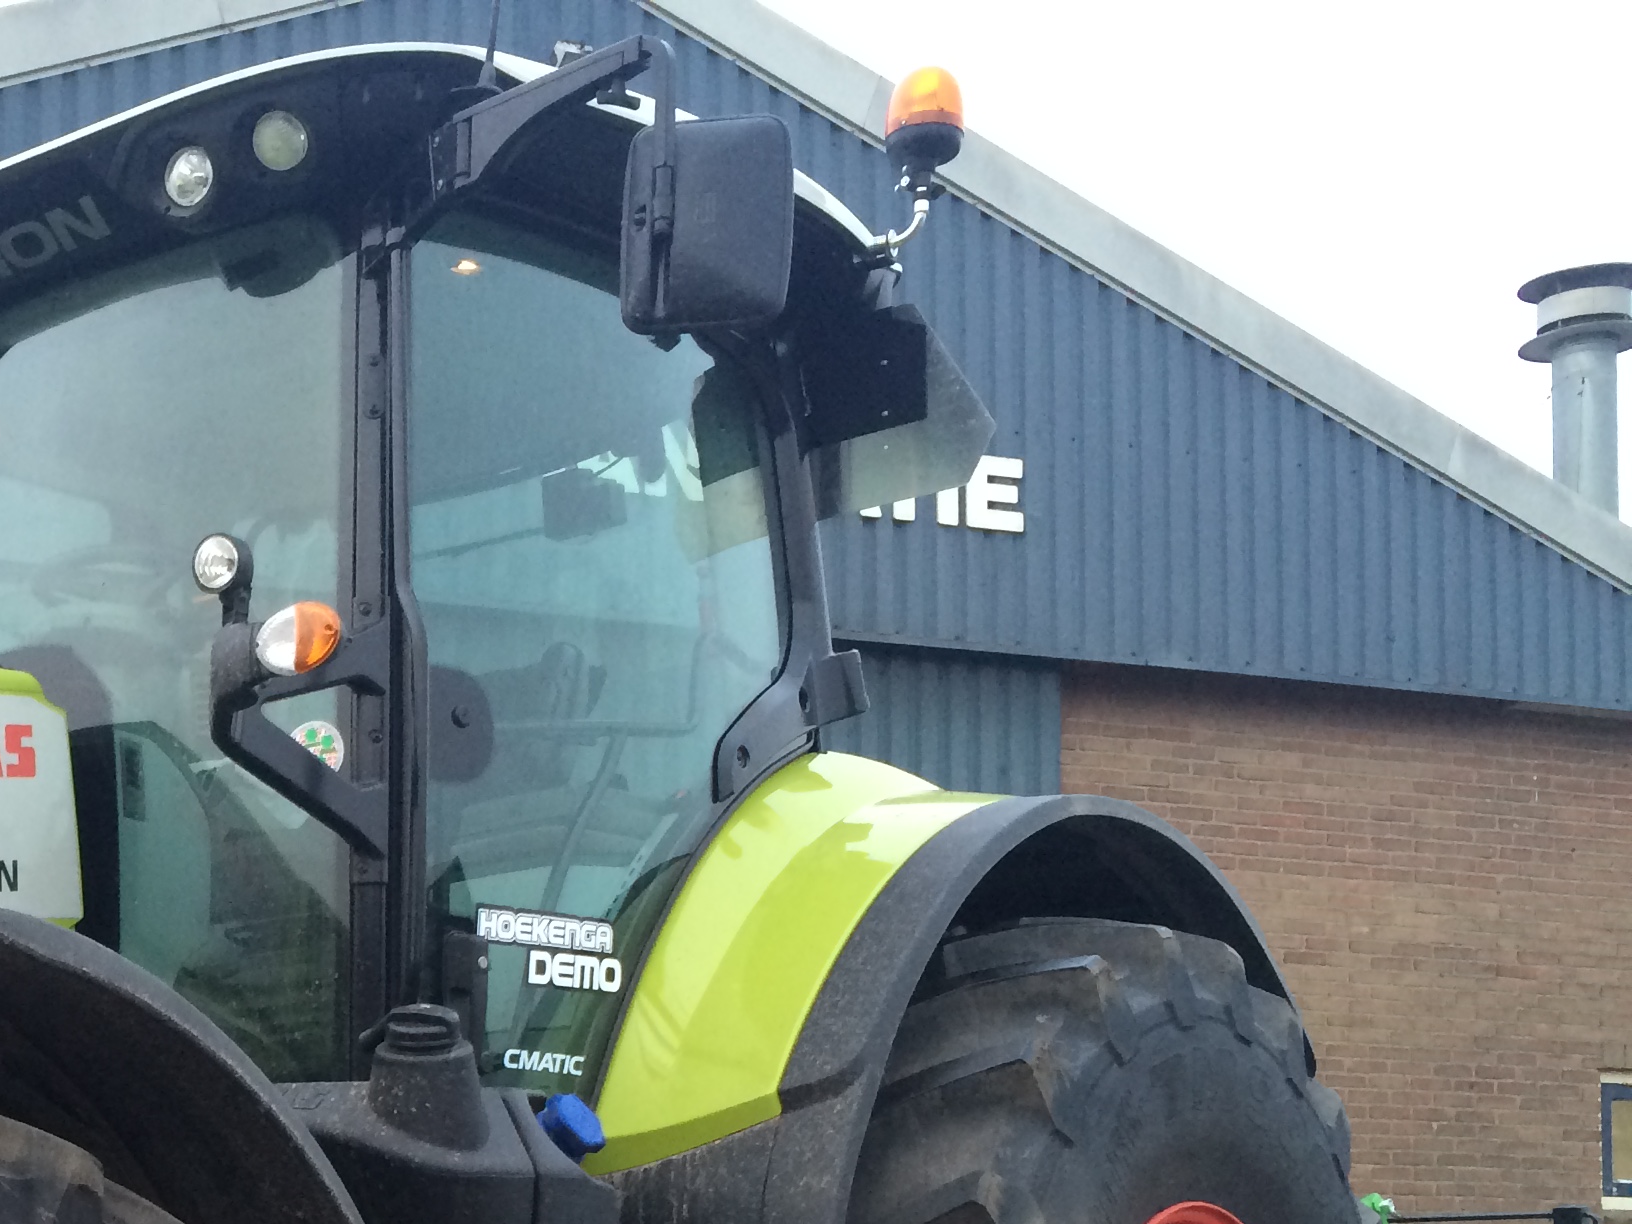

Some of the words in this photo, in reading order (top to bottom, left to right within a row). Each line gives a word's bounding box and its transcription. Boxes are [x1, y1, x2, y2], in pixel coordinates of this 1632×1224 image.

[477, 908, 613, 953] HOEKENGA
[528, 950, 622, 992] DEMO
[503, 1049, 585, 1076] CMATIC
